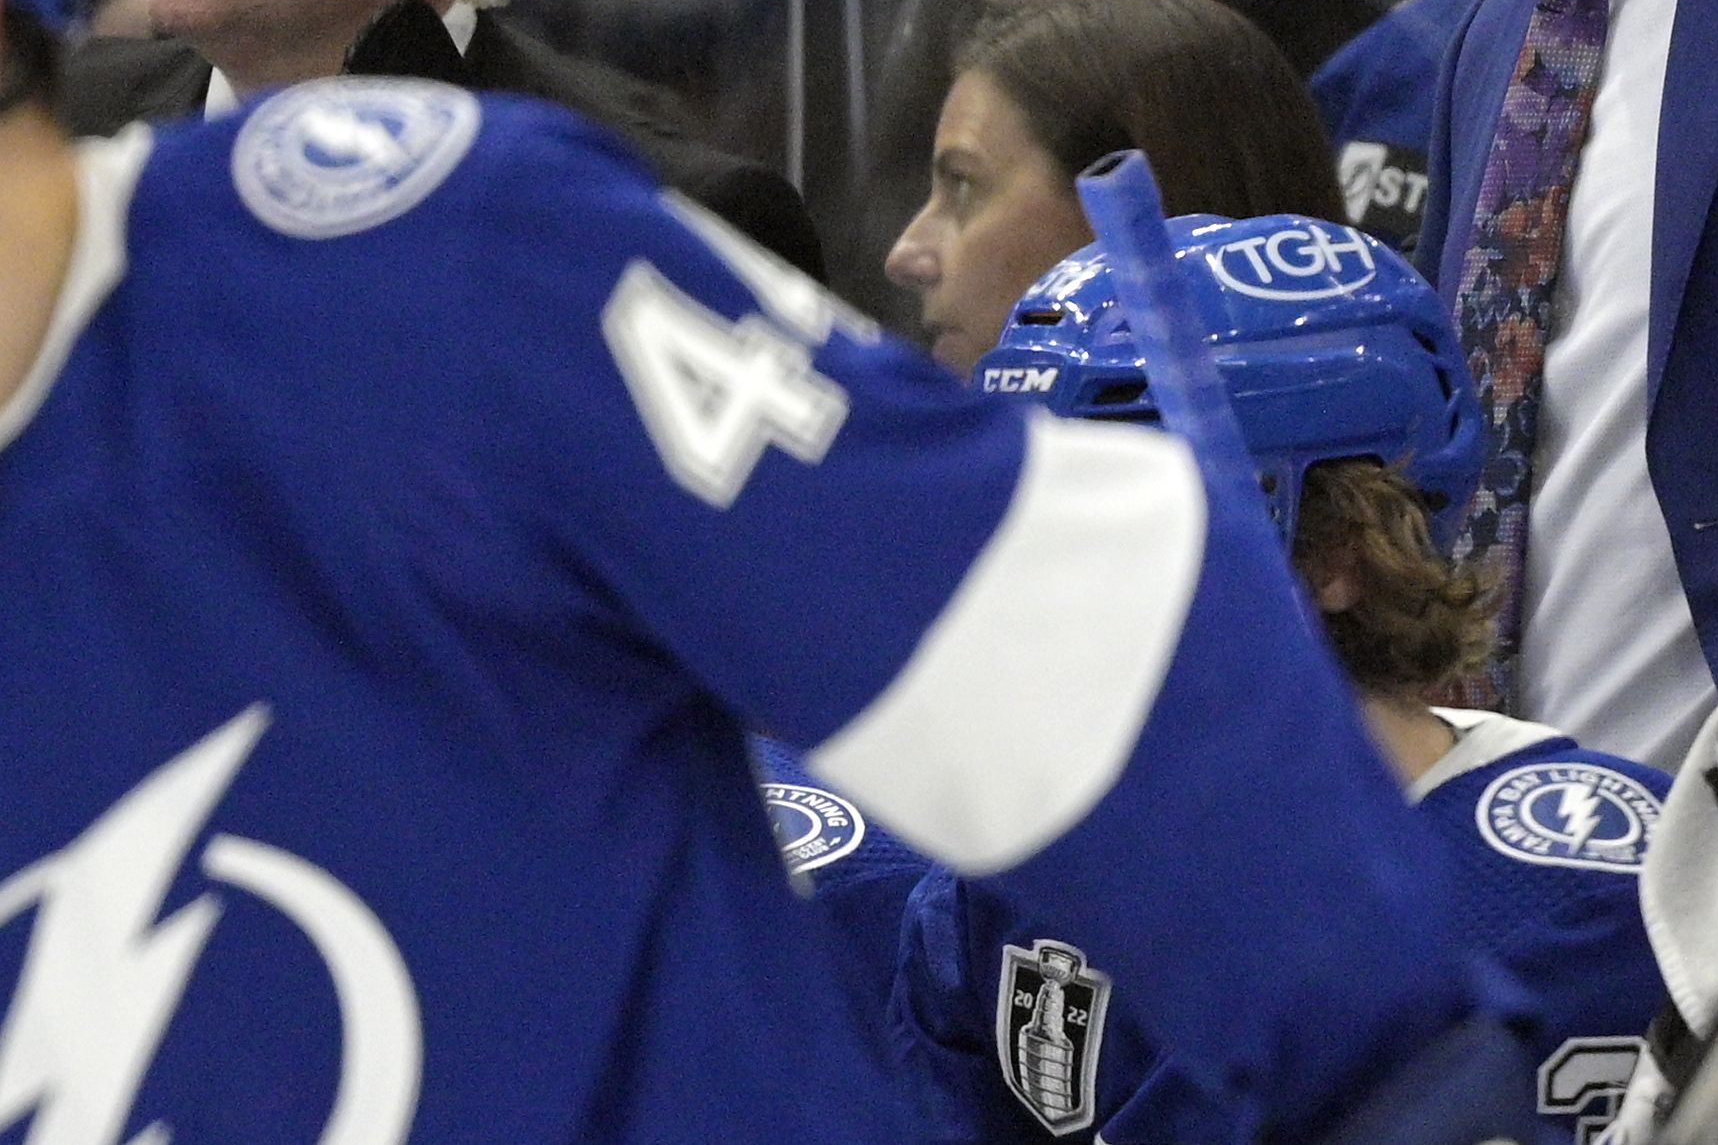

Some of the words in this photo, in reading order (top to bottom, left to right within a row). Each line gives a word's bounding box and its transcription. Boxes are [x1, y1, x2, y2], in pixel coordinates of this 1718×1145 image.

[1226, 225, 1376, 285] TGH
[983, 368, 1059, 393] CCM
[1498, 771, 1543, 803] BAY
[1491, 804, 1551, 855] TAMPA
[1014, 989, 1034, 1010] 20
[1067, 1005, 1088, 1027] 22
